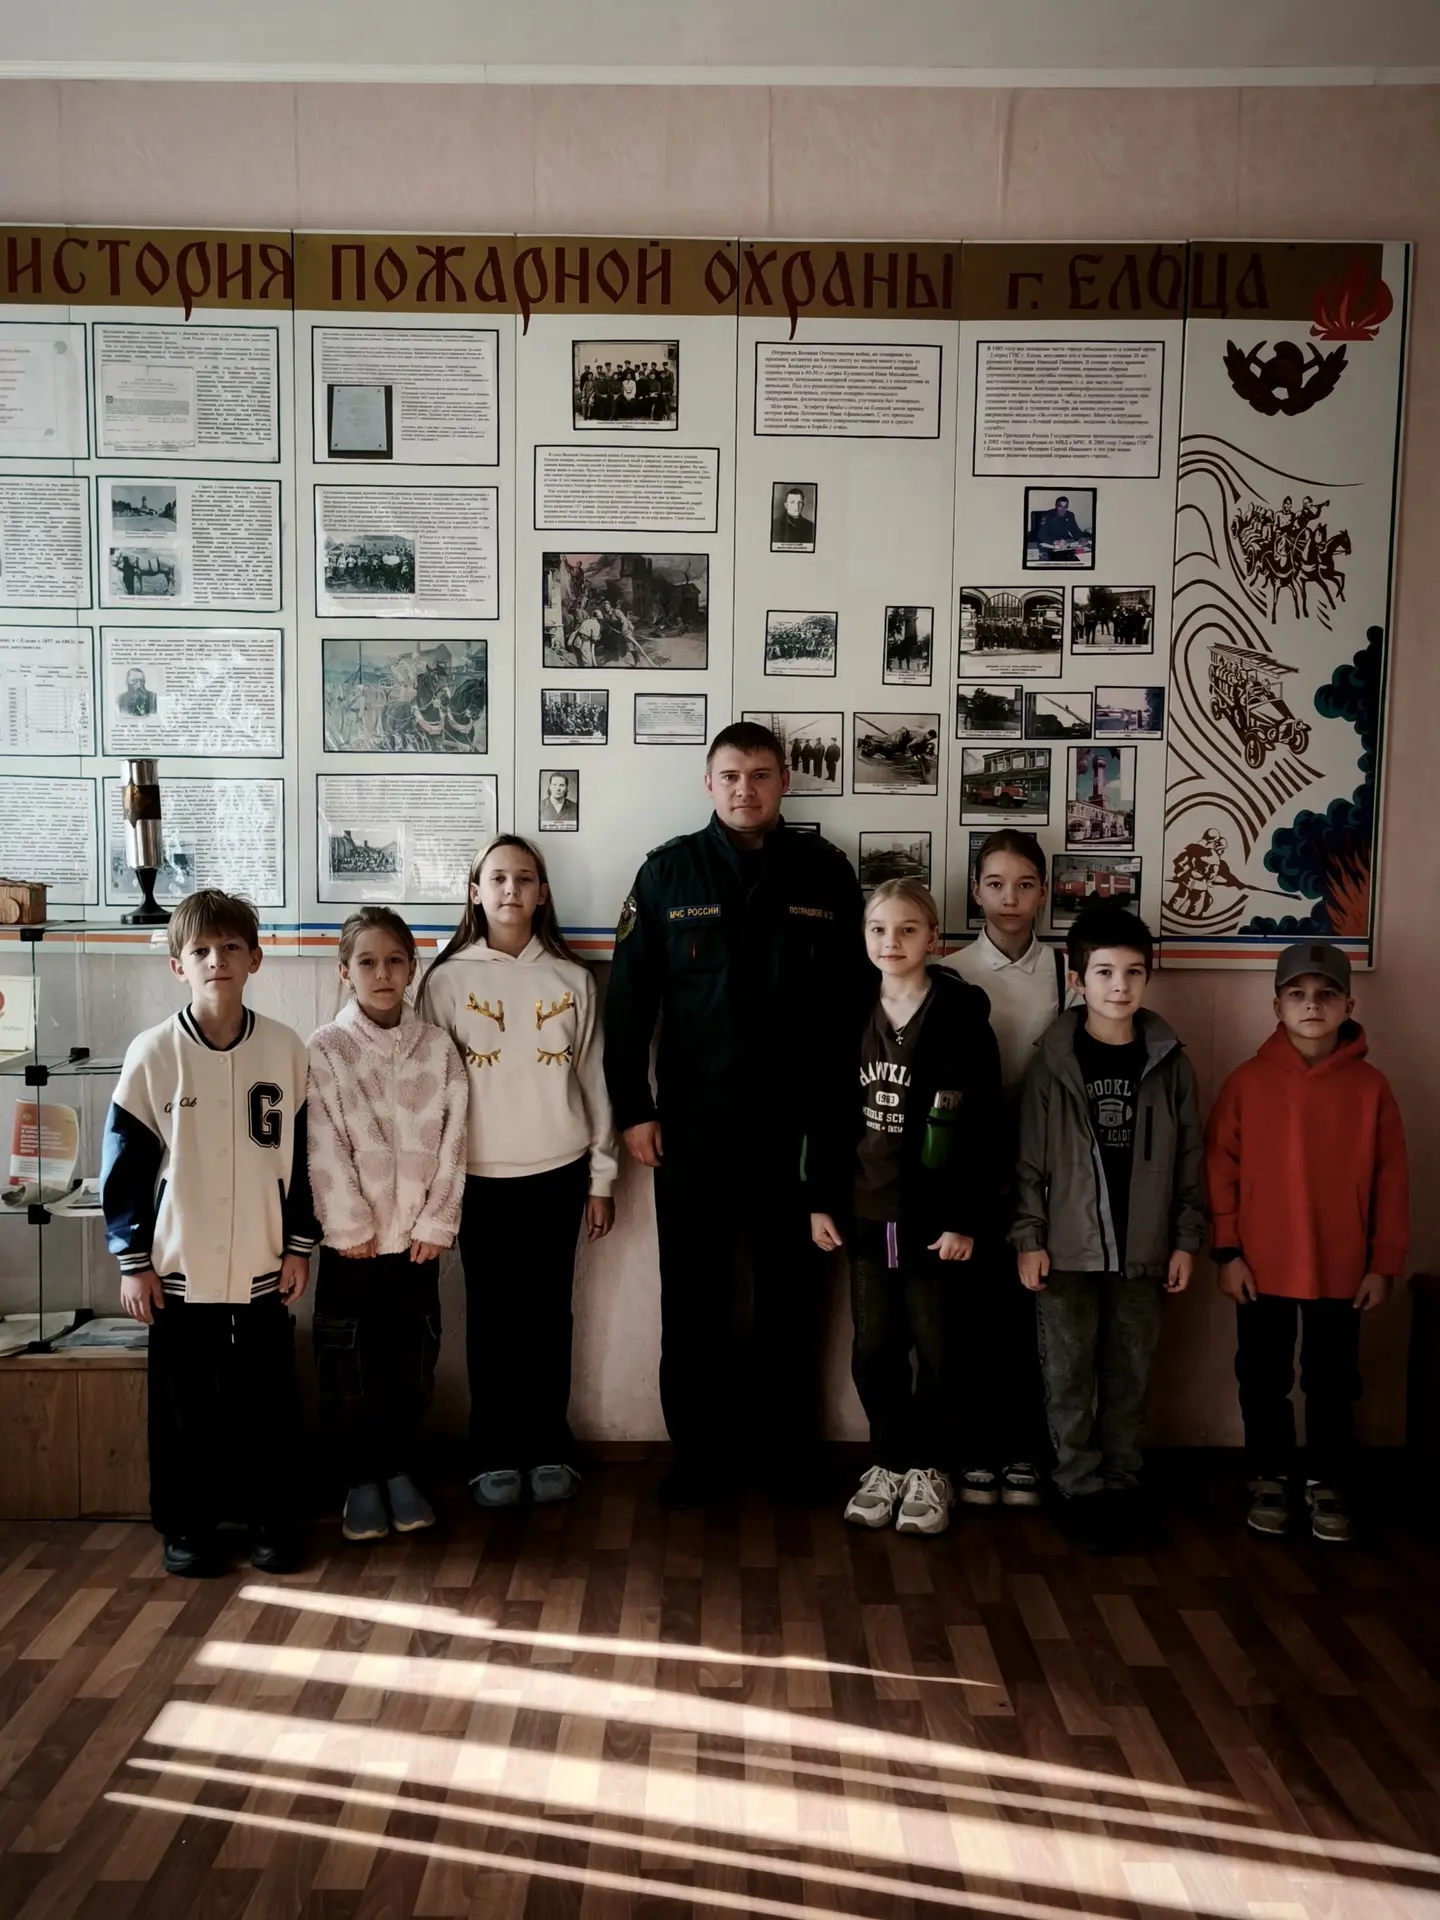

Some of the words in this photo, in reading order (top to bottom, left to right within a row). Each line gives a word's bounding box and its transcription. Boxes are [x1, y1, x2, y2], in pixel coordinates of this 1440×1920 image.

[7, 237, 294, 322] ИСТОРИЯ
[332, 241, 671, 336] ПОЖАРНОЙ
[704, 249, 954, 340] ОХРАНЫ
[669, 909, 685, 919] МЧС
[687, 906, 719, 917] РОССИИ
[247, 1081, 283, 1149] G
[877, 1094, 896, 1104] 1983
